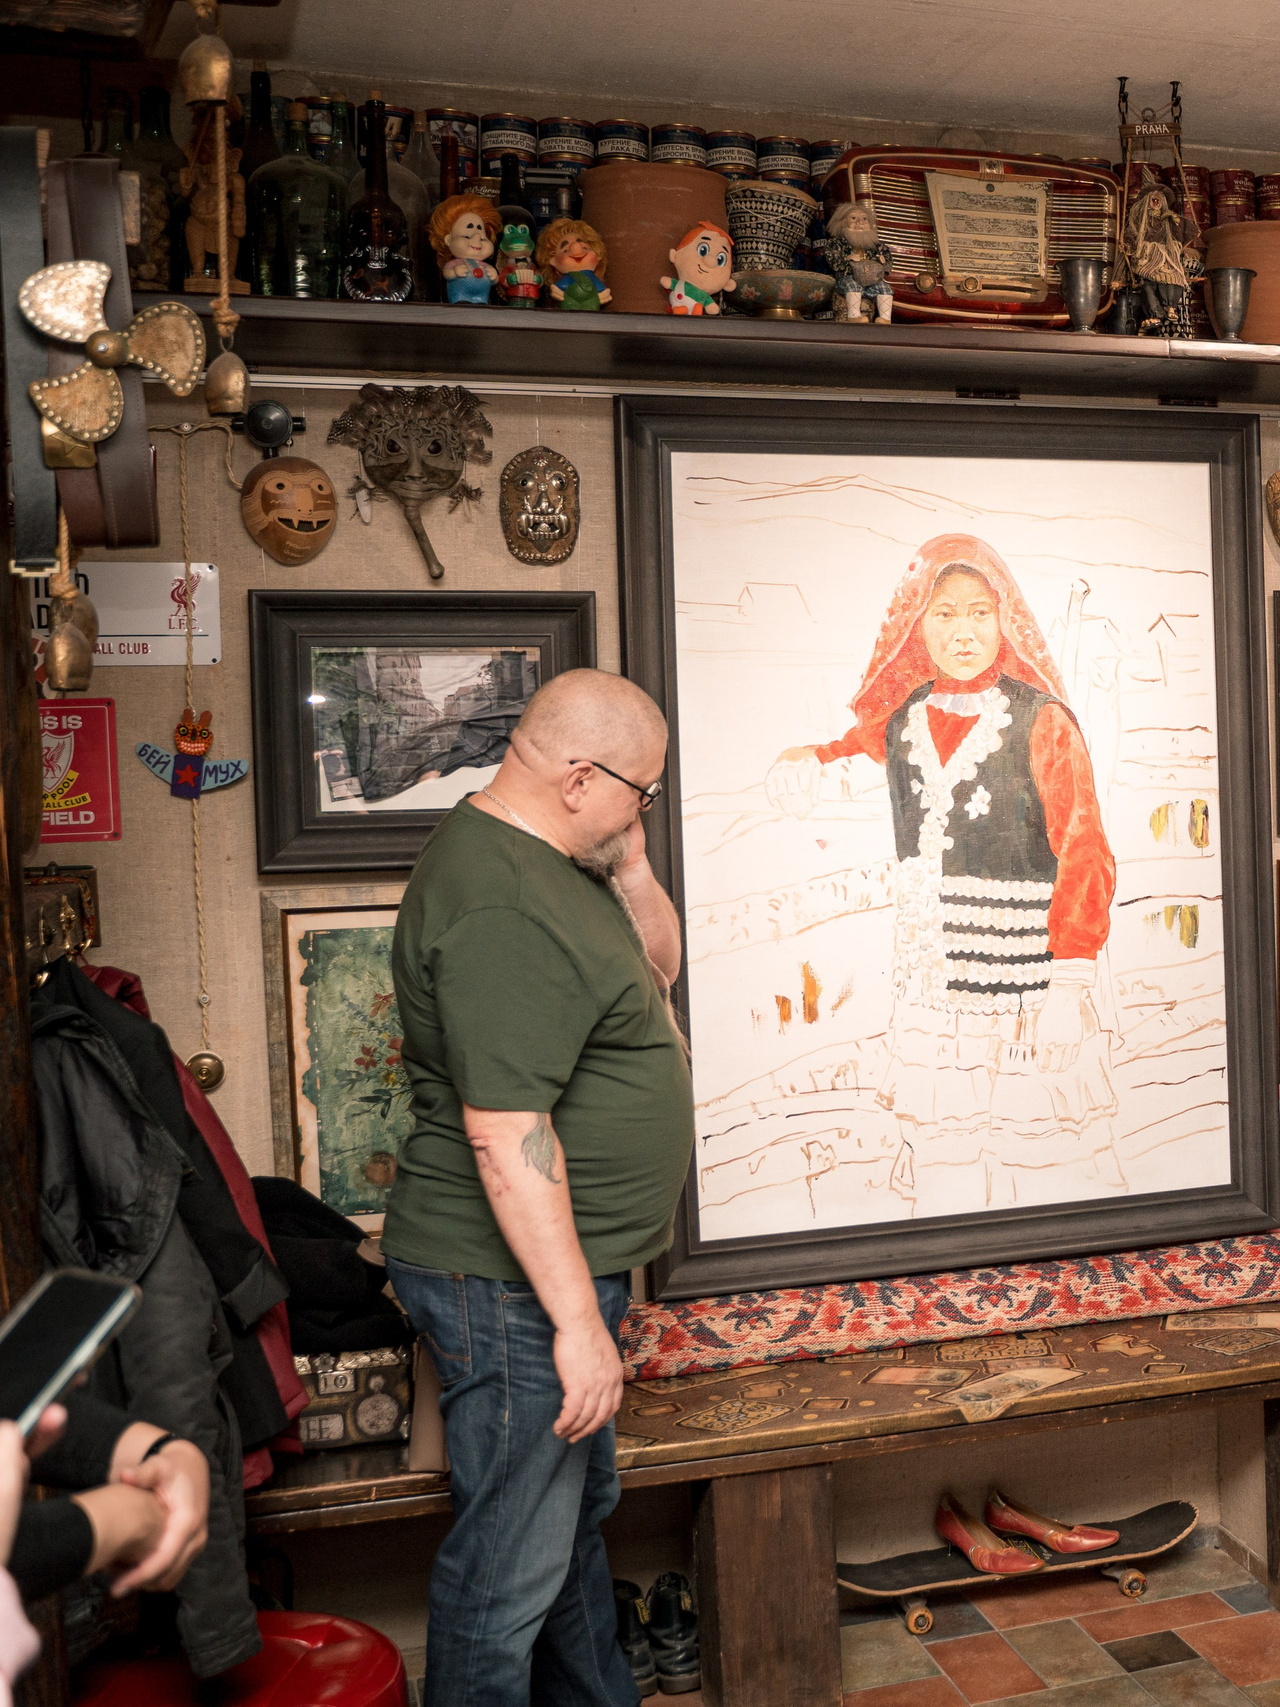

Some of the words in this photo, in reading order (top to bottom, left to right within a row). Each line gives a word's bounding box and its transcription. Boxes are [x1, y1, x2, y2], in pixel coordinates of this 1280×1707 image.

[487, 132, 519, 140] ЗАЩИТИТЕ
[1135, 123, 1170, 136] PRAHA
[490, 138, 525, 147] ТАБАЧНОГО
[544, 138, 573, 146] КУРЕНИЕ
[93, 642, 116, 655] ALL
[117, 642, 149, 655] CLUB
[61, 714, 83, 730] IS
[138, 743, 172, 775] БЕЙ
[202, 760, 245, 787] МУХ
[65, 795, 88, 807] CLUB
